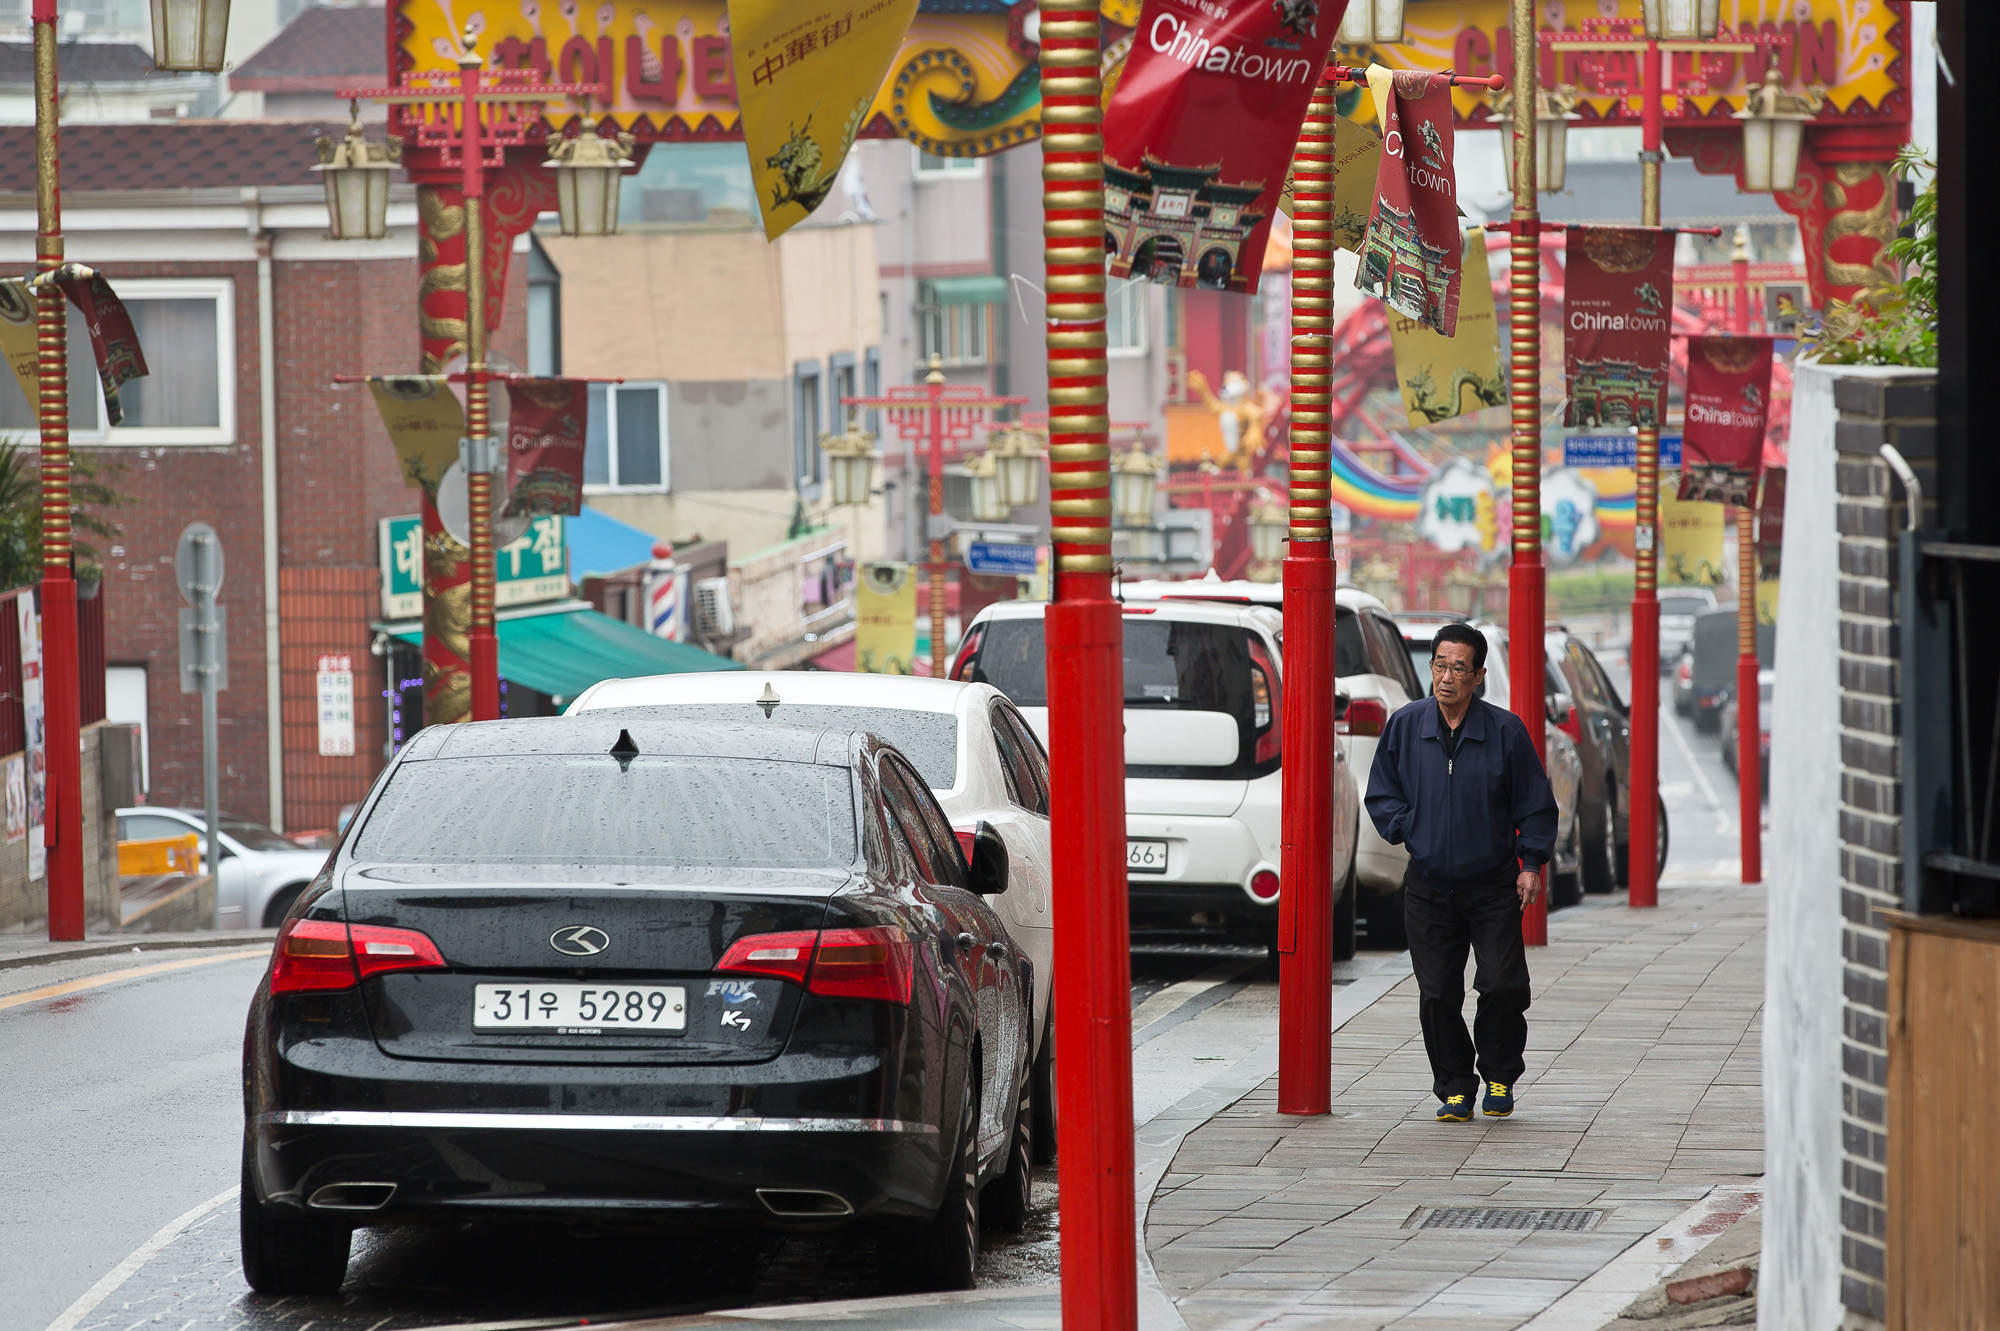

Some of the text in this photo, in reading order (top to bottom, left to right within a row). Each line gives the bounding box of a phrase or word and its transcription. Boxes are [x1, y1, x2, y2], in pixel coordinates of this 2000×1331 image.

[753, 10, 854, 87] 中華街
[1150, 12, 1311, 84] Chinatown
[1338, 140, 1379, 167] 차이나타운
[1570, 311, 1667, 332] Chinatown
[1688, 403, 1765, 428] Chinatown
[1128, 845, 1155, 864] 66
[704, 981, 756, 997] FOX
[493, 990, 667, 1022] 31우 5289
[720, 1010, 752, 1032] K7
